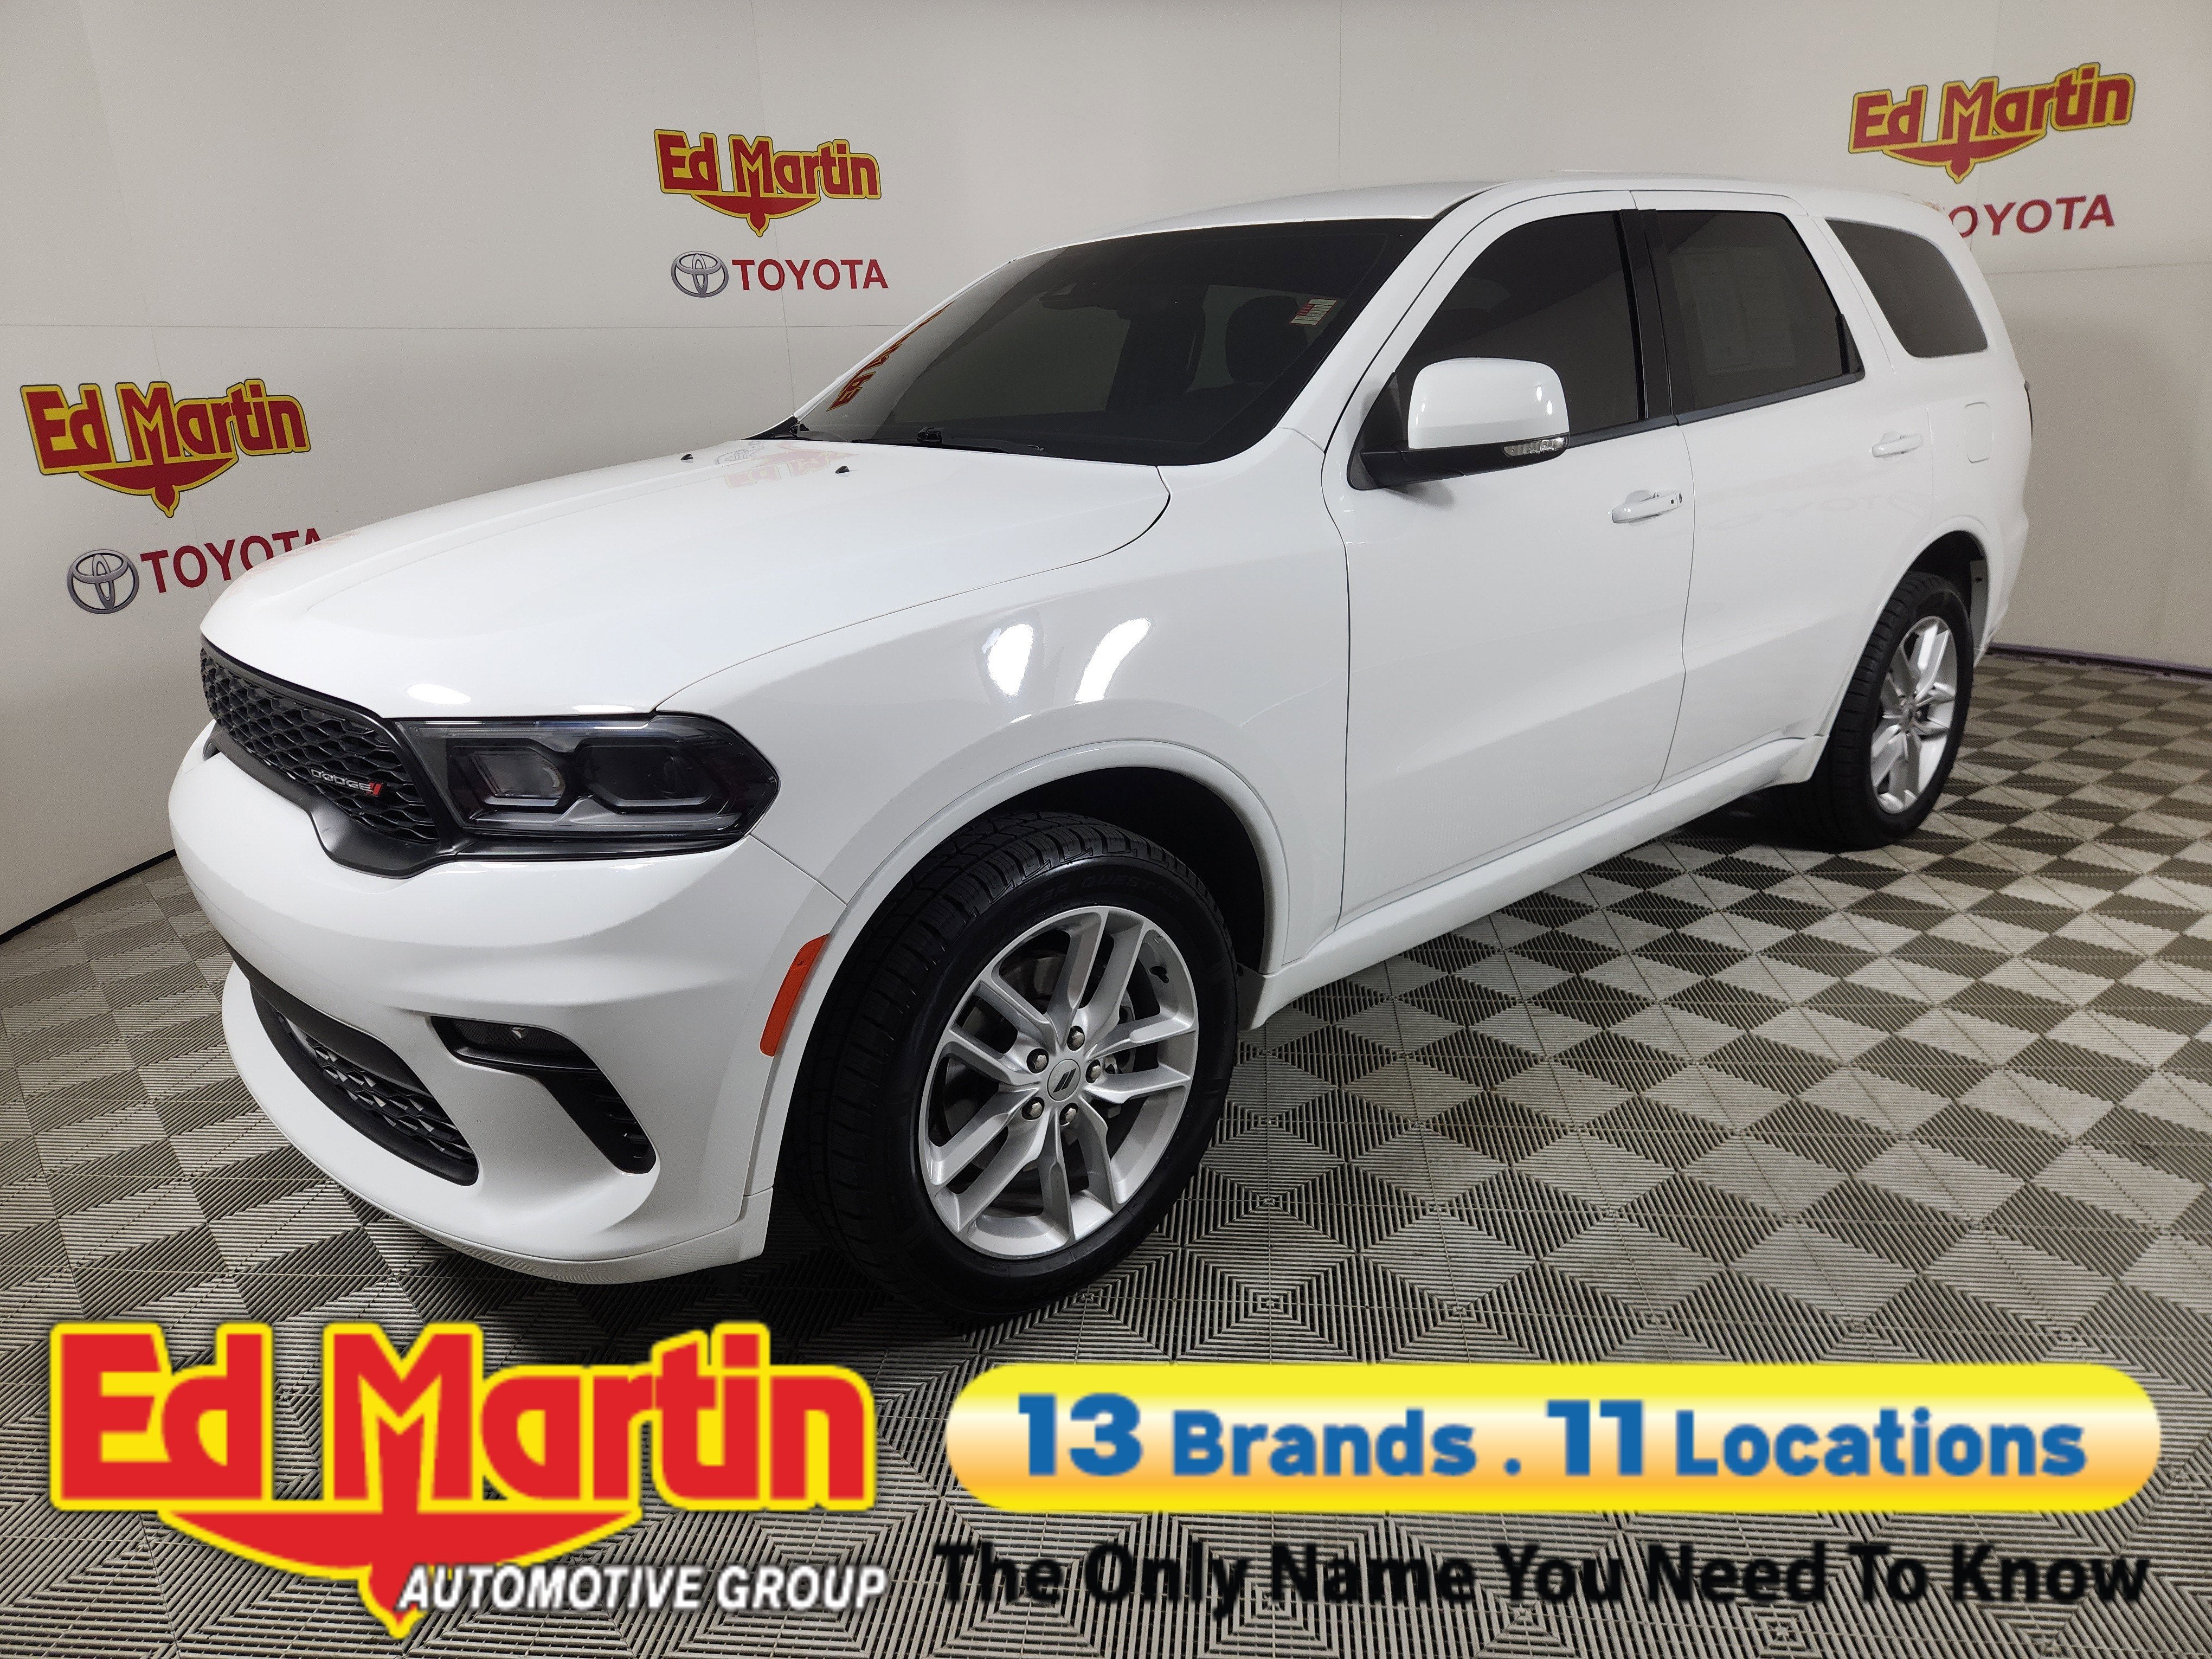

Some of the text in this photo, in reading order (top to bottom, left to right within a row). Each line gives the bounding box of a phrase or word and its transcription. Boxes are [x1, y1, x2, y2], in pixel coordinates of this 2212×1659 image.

[1849, 62, 2136, 153] Ed Martin
[654, 129, 882, 200] Ed Martin
[1947, 194, 2115, 239] OYOTA
[732, 259, 889, 291] TOYOTA
[20, 378, 311, 475] Ed Martin
[311, 769, 374, 792] DODGE
